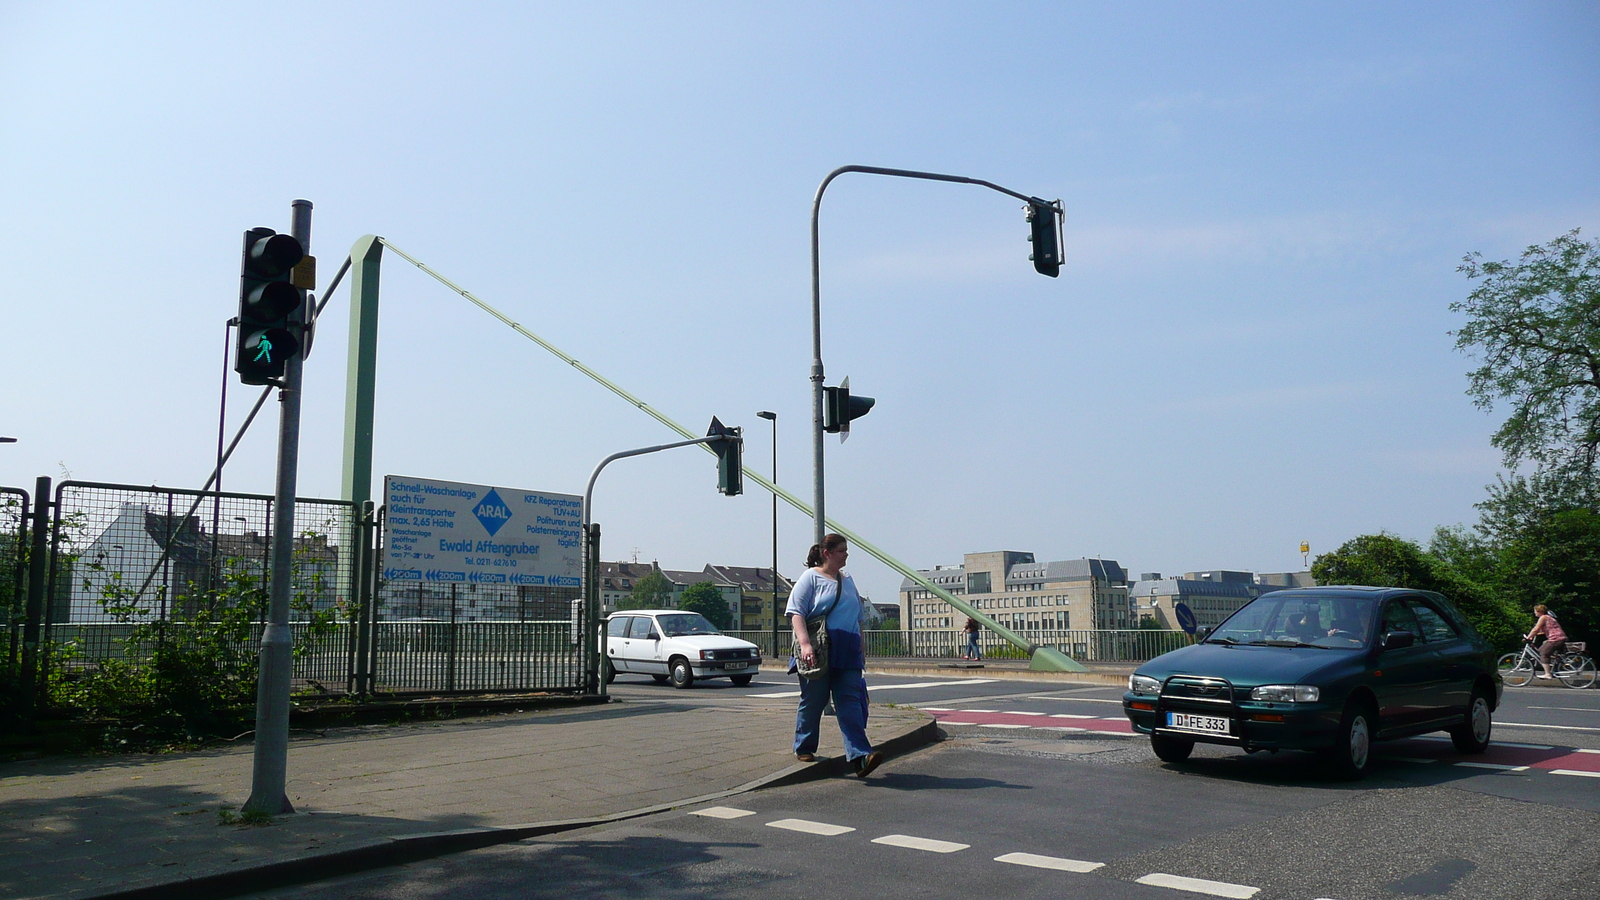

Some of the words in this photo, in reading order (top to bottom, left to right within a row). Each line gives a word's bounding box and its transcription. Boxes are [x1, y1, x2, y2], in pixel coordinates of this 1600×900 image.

[391, 482, 476, 500] Schnell-Waschanlage
[391, 494, 411, 503] auch
[413, 495, 425, 504] für
[524, 495, 537, 504] KFZ
[539, 497, 580, 508] Reparaturen
[390, 504, 456, 518] Kleintransporter
[477, 504, 508, 519] ARAL
[389, 517, 410, 525] max.
[413, 517, 430, 527] 2,65
[432, 518, 454, 528] Höhe
[537, 516, 566, 526] Polituren
[392, 528, 432, 538] Waschanlage
[527, 525, 579, 539] Polsterreinigung
[439, 539, 472, 552] Ewald
[475, 541, 540, 557] Affengruber
[558, 538, 579, 548] täglich
[464, 557, 475, 565] Tel.
[393, 570, 418, 579] 200m
[438, 572, 463, 580] 200m
[481, 574, 503, 582] 200m
[521, 575, 543, 583] 200m
[558, 577, 578, 585] 200m
[1176, 714, 1183, 726] D
[1190, 716, 1203, 728] FE
[1205, 718, 1225, 731] 333
